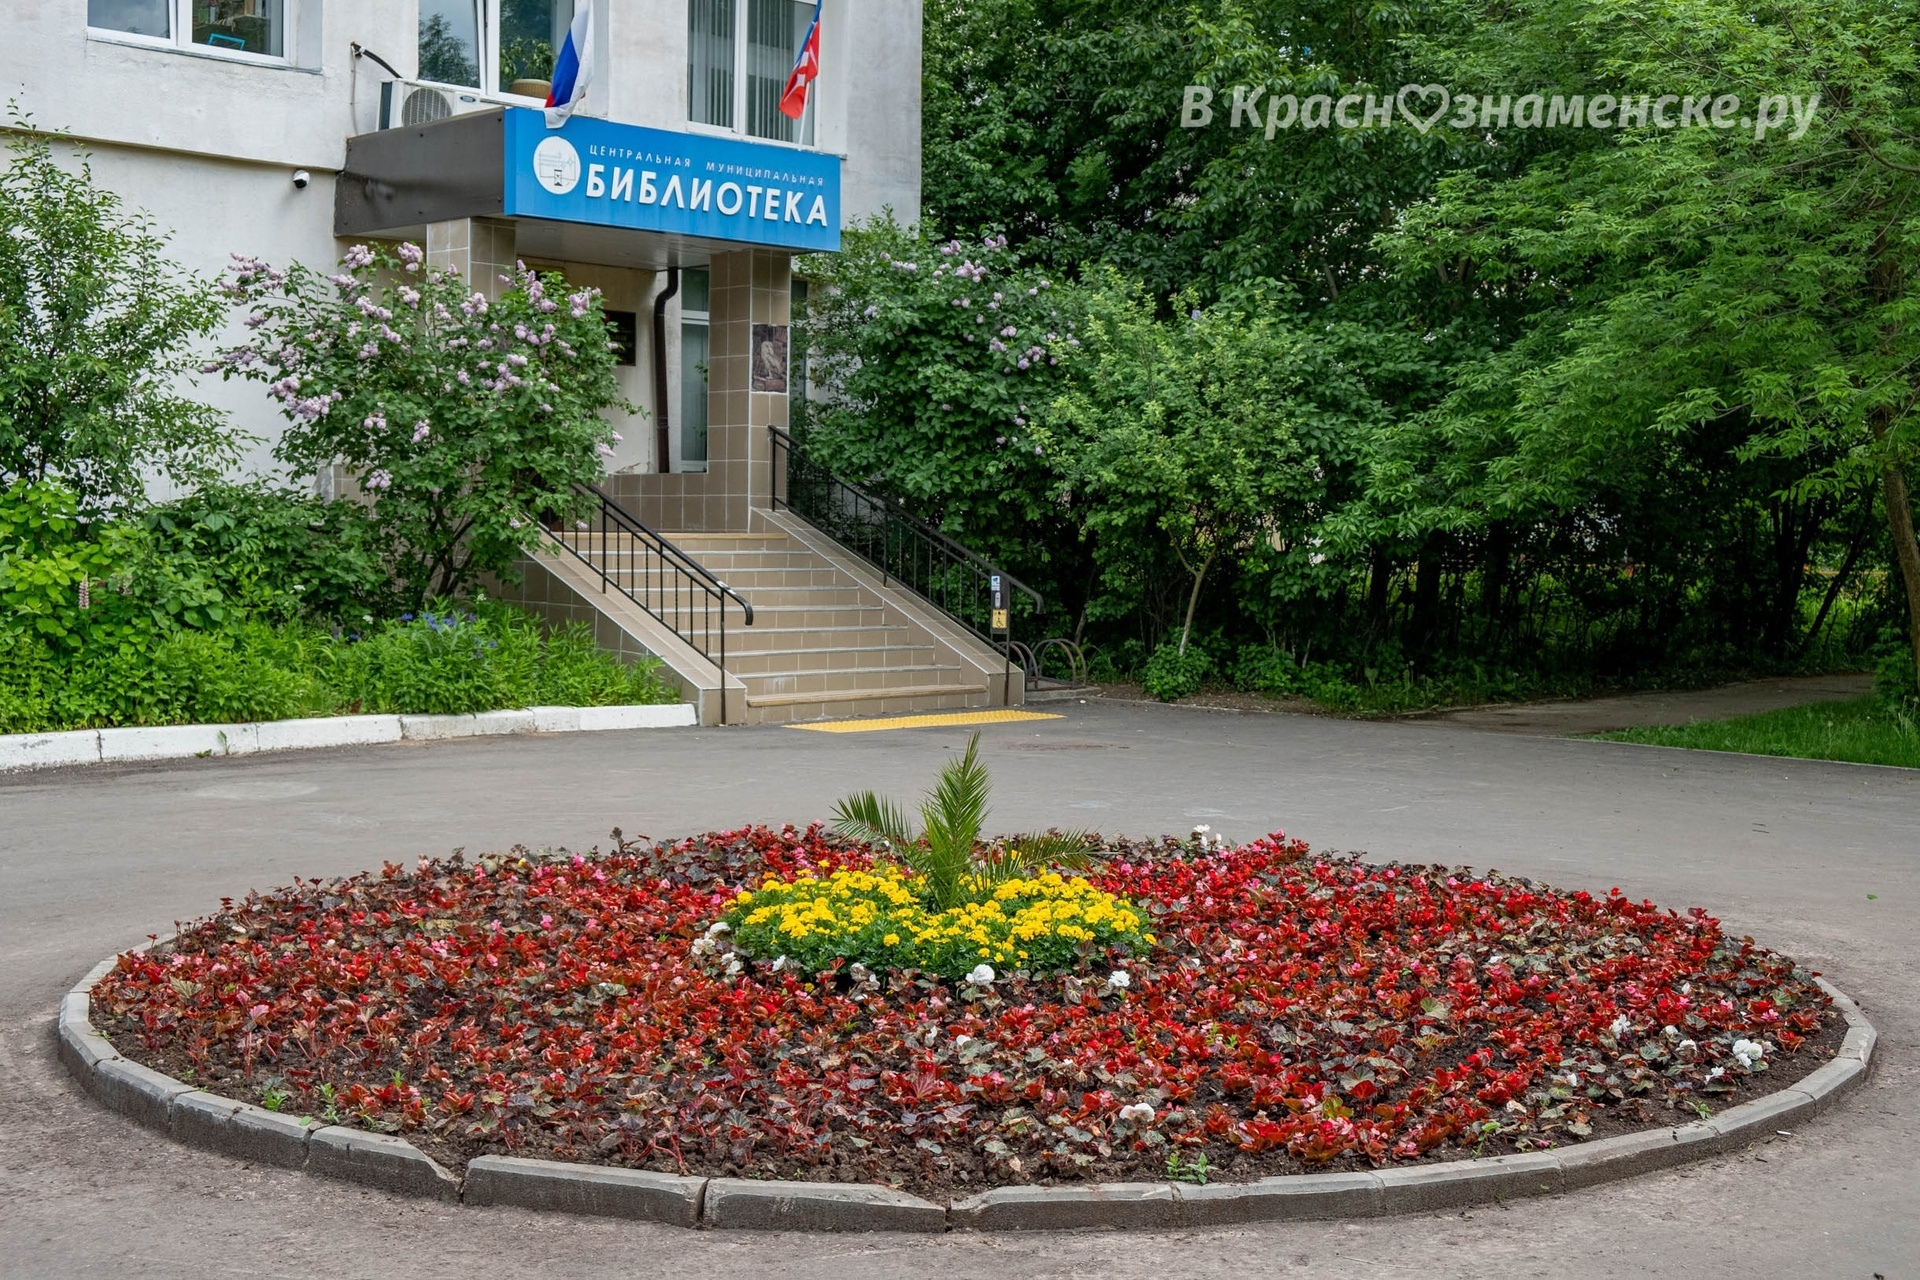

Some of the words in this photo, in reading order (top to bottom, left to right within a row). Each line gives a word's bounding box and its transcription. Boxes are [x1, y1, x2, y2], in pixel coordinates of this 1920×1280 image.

[590, 144, 691, 167] ЦЕНТРАЛЬНАЯ
[706, 161, 824, 187] МУНИЦИПАЛЬНАЯ
[586, 163, 828, 227] БИБЛИОТЕКА
